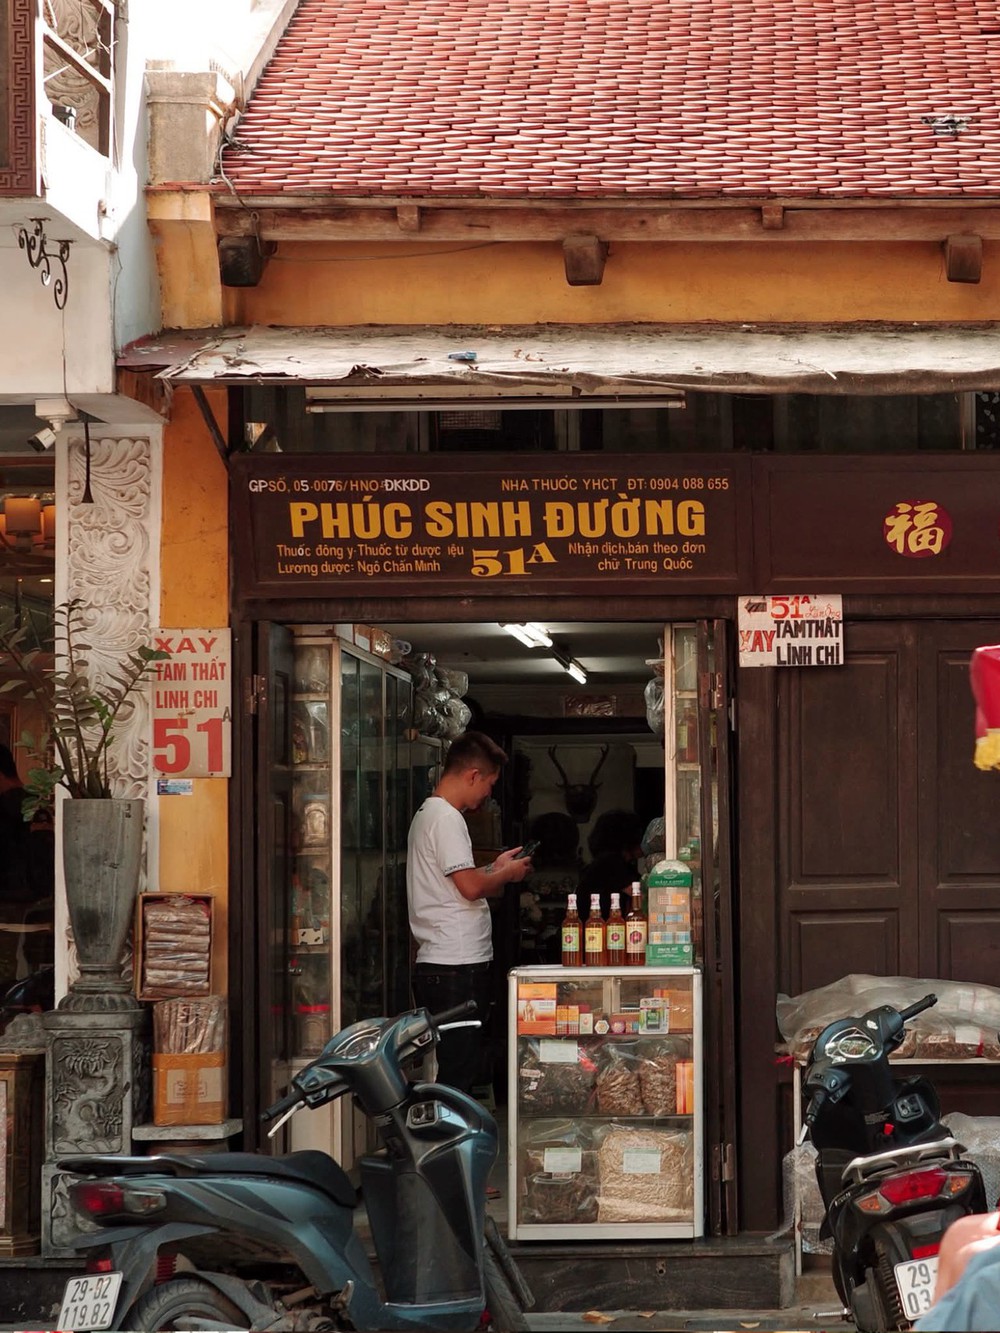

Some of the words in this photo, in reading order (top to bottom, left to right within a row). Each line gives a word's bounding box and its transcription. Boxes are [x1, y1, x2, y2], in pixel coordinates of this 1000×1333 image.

[583, 478, 618, 491] YHCT
[627, 478, 648, 490] ĐT:
[650, 477, 679, 490] 0904
[683, 477, 704, 490] 088
[707, 477, 729, 490] 655
[289, 494, 413, 540] PHÚC
[425, 500, 532, 539] SINH
[543, 492, 706, 539] ĐƯỜNG
[276, 543, 312, 557] Thuốc
[315, 544, 344, 560] đông
[395, 543, 408, 557] từ
[412, 543, 442, 558] dược
[568, 541, 599, 558] Nhận
[653, 541, 679, 555] theo
[682, 541, 706, 554] đơn
[277, 561, 319, 577] Lương
[321, 560, 354, 577] dược:
[357, 560, 381, 576] Ngô
[415, 559, 441, 573] Minh
[471, 542, 559, 578] 51A
[598, 557, 620, 571] chữ
[624, 557, 658, 573] Trung
[663, 555, 694, 571] Quốc
[154, 637, 218, 653] XAY
[739, 629, 777, 653] XAY
[776, 642, 812, 666] LINH
[155, 662, 187, 681] TAM
[191, 656, 227, 681] THẤT
[156, 690, 189, 709] LINH
[193, 689, 218, 709] CHI
[62, 1302, 110, 1329] 119.82
